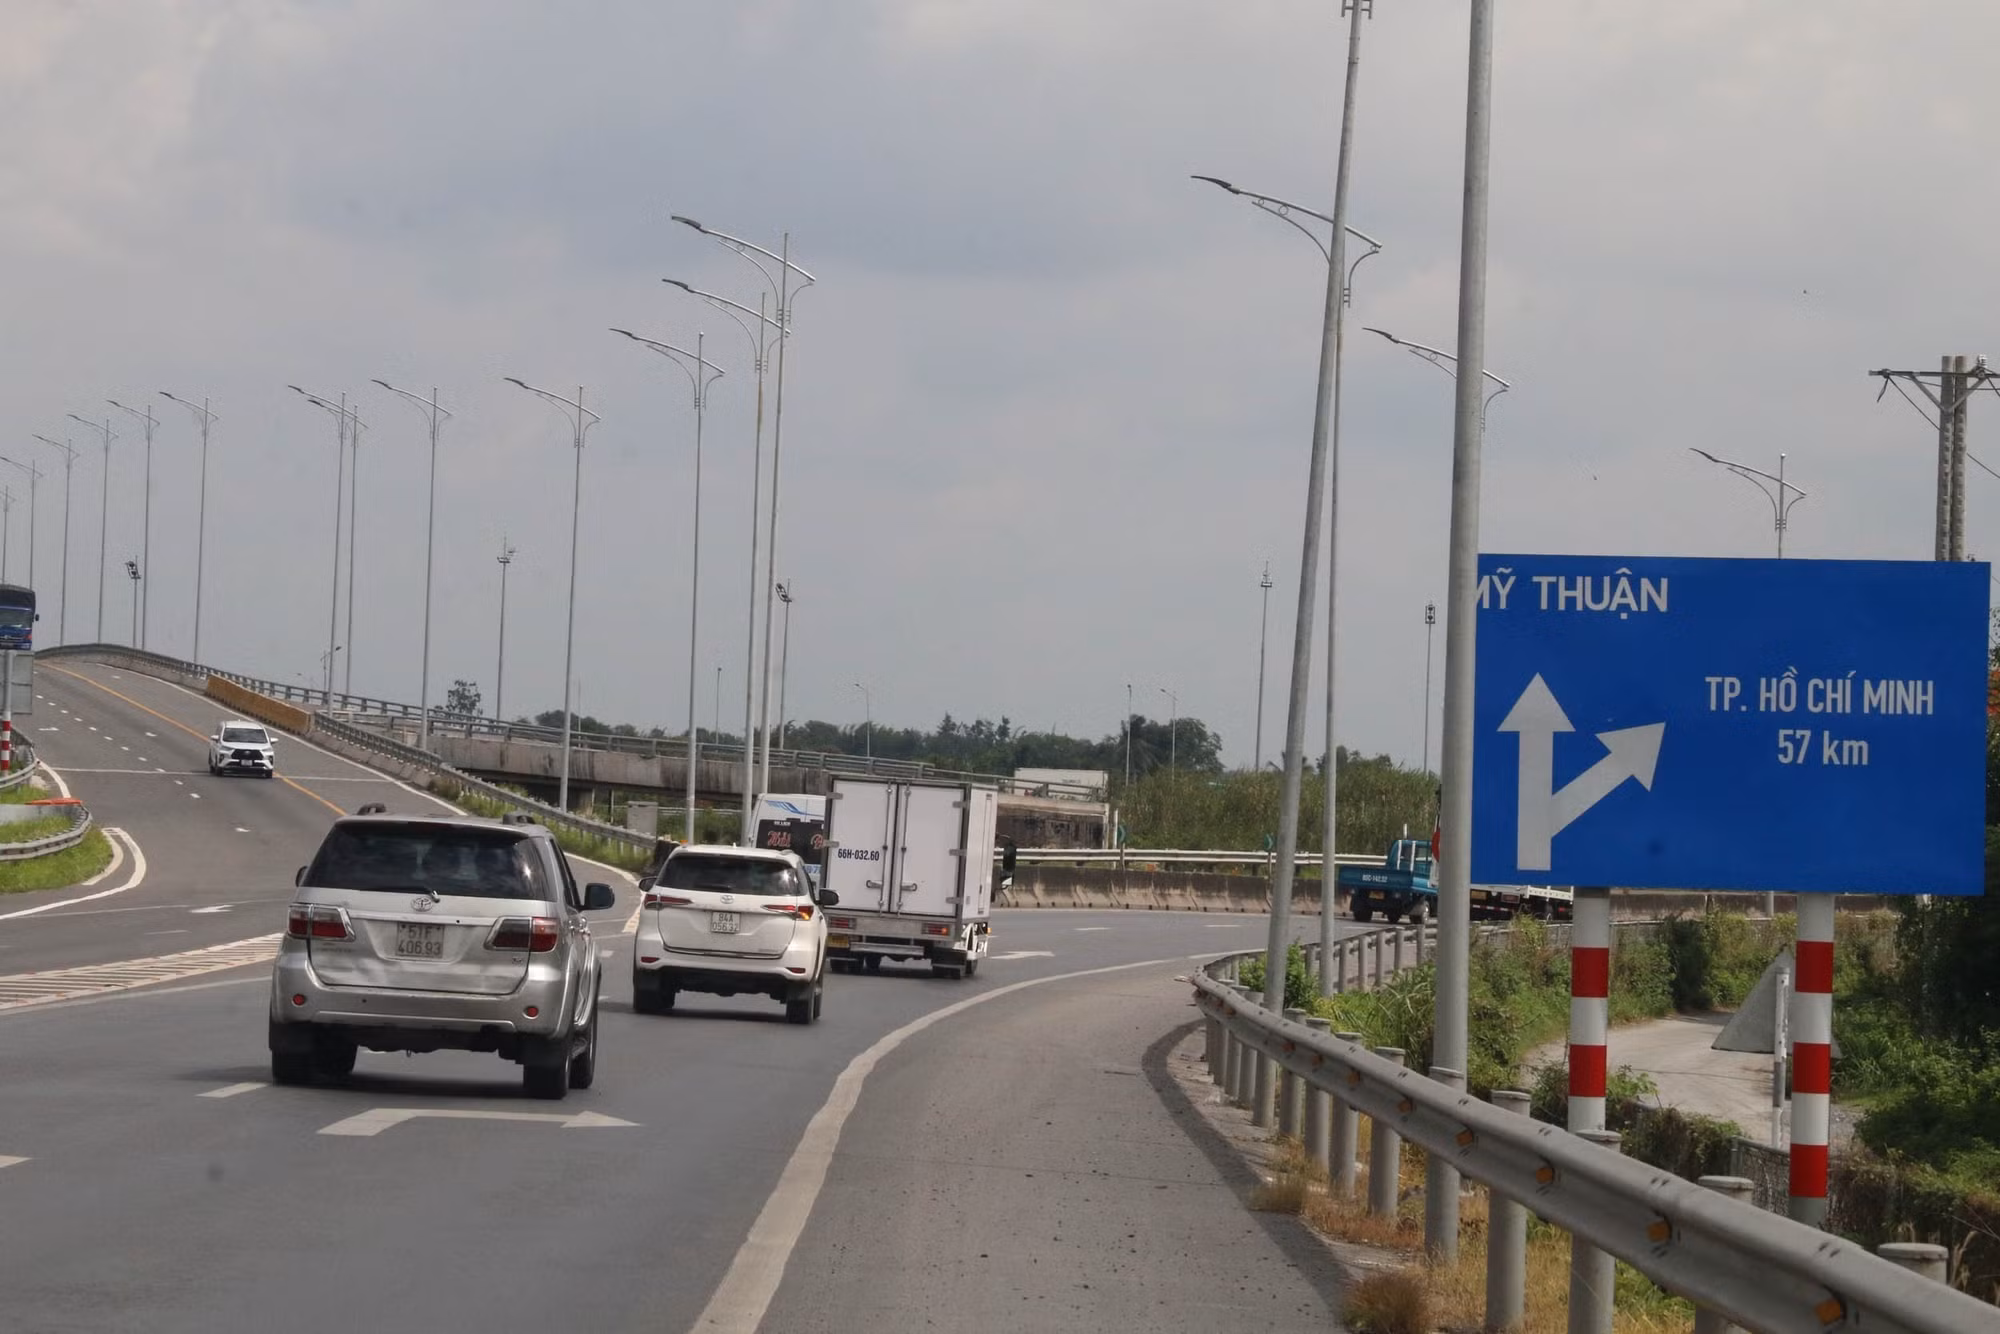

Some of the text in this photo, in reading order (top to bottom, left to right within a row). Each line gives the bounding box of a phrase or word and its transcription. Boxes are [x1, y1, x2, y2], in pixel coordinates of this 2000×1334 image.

[1532, 567, 1669, 620] THUẬN
[1705, 666, 1935, 716] TP. HỒ CHÍ MINH
[1777, 729, 1870, 766] 57 km
